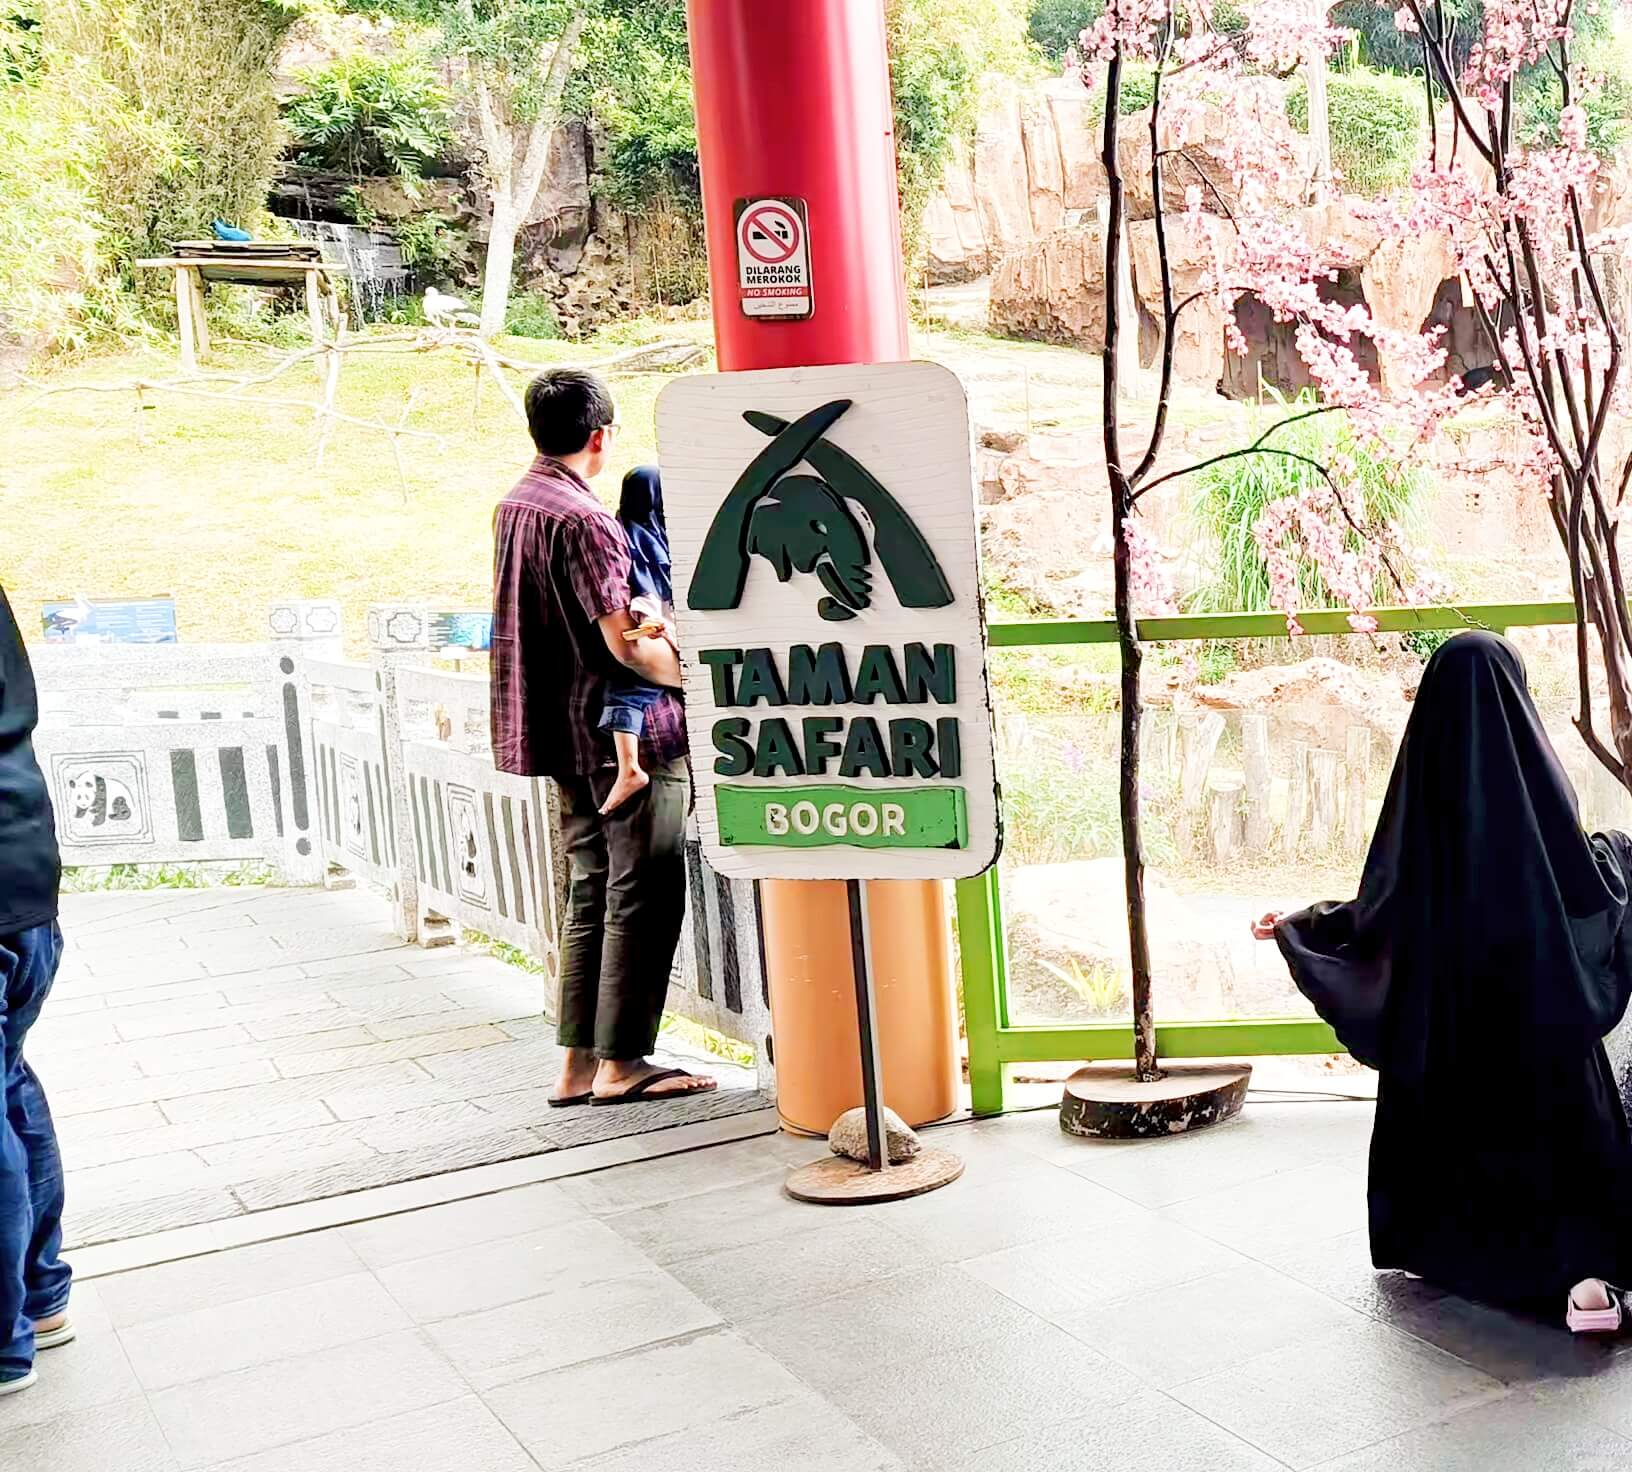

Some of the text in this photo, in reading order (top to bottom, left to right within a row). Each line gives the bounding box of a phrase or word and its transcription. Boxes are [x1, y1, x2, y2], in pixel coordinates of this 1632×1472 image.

[746, 265, 801, 275] DILARANG
[746, 274, 801, 284] MEROKOK
[746, 287, 803, 297] NO SMOKING
[699, 642, 957, 707] TAMAN
[711, 717, 961, 778] SAFARI
[765, 800, 906, 836] BOGOR
